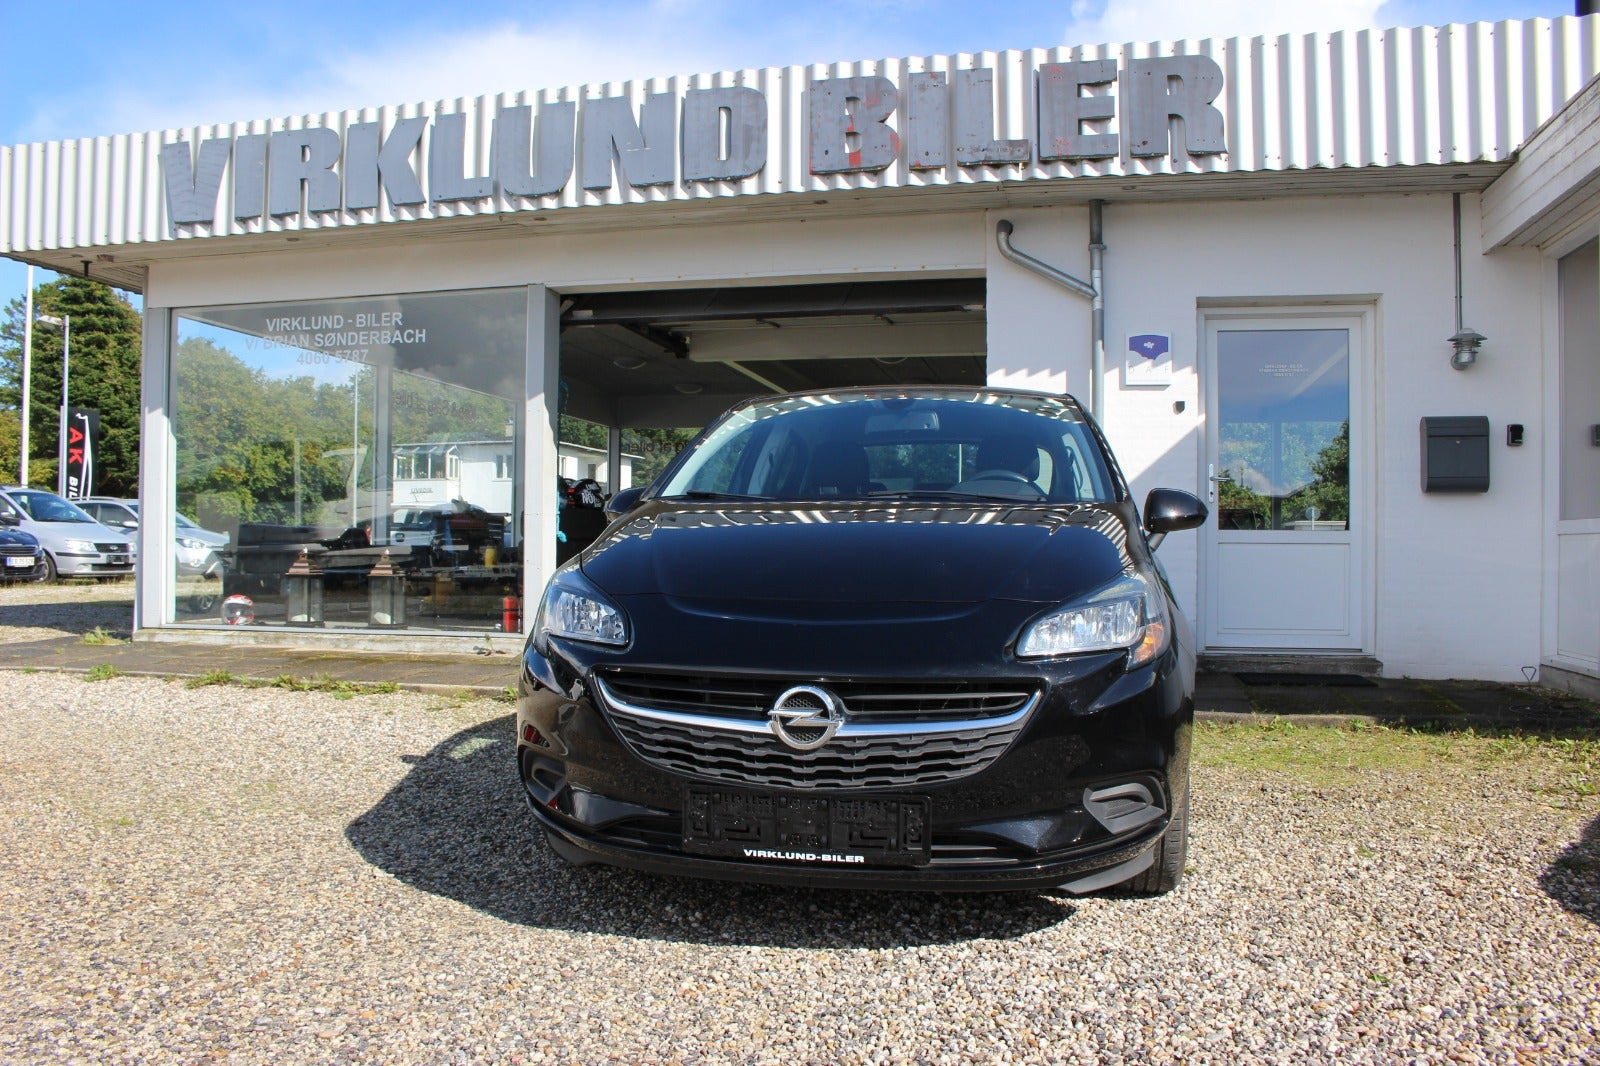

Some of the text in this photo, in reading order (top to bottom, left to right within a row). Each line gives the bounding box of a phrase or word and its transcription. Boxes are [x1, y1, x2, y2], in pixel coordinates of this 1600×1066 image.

[161, 55, 1228, 225] VIRKLUND BILER
[266, 315, 344, 332] VIRKLUND
[356, 312, 403, 328] BILER
[263, 334, 310, 350] BRIAN
[314, 328, 426, 348] SØNDERBACH
[68, 426, 84, 465] AK
[743, 848, 865, 863] VIRKLUND-BILER
